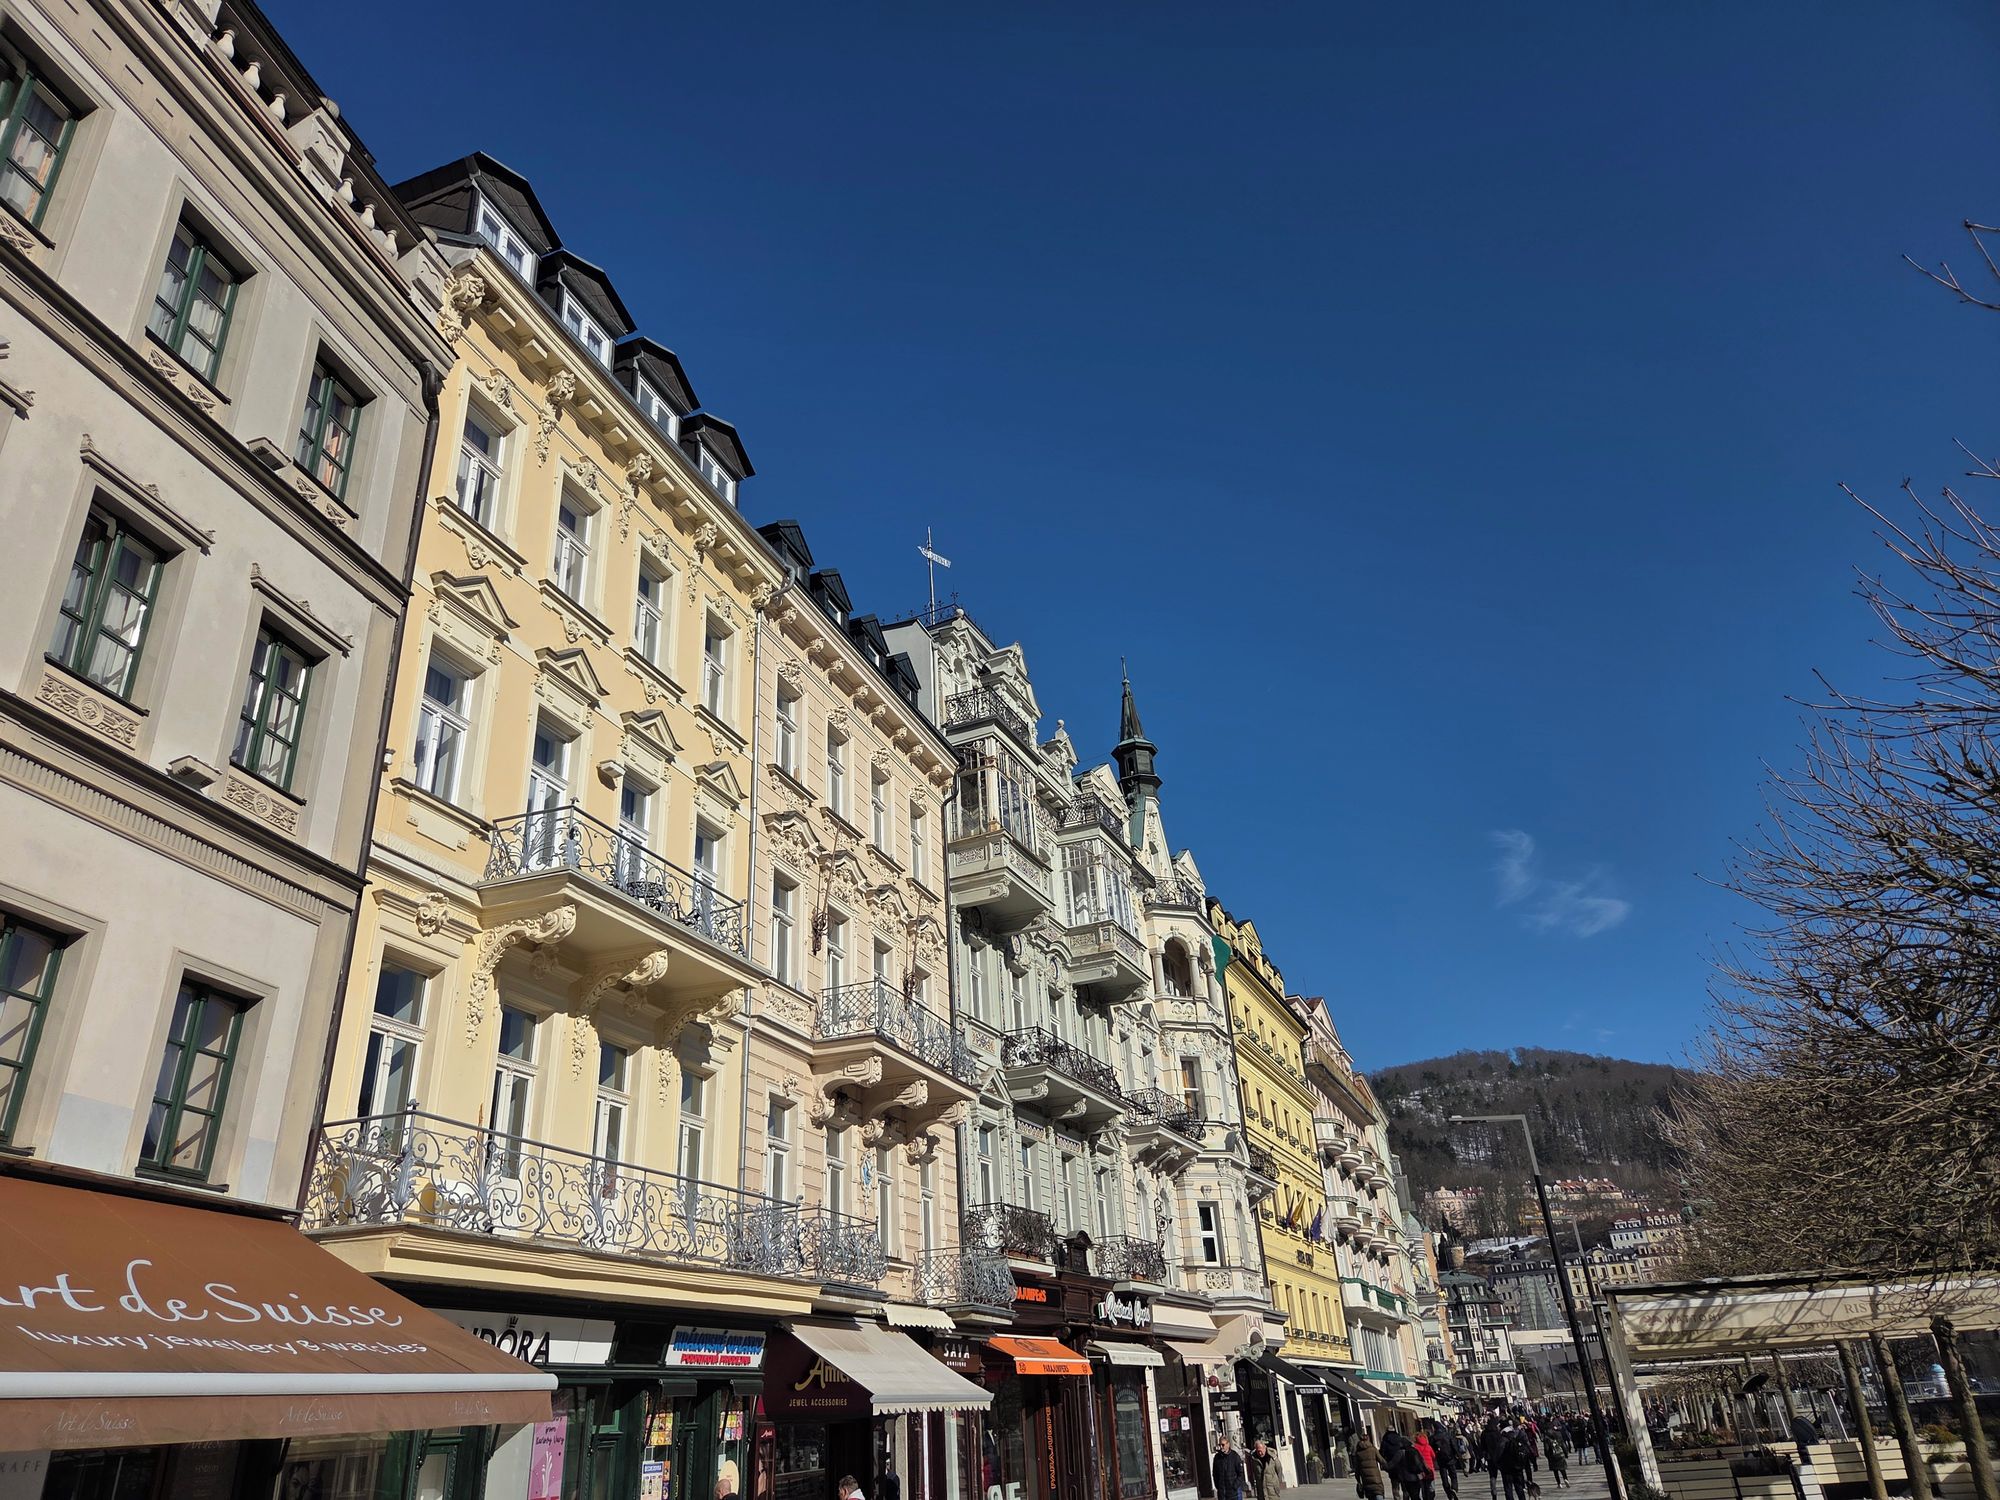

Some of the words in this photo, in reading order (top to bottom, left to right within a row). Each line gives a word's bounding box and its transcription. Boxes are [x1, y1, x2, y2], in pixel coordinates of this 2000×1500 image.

[0, 1274, 105, 1312] rt
[119, 1259, 209, 1322] de
[204, 1282, 403, 1328] Suisse
[16, 1325, 149, 1350] luxury
[148, 1333, 299, 1355] jewellery
[296, 1339, 321, 1352] &
[322, 1341, 427, 1354] watches
[943, 1342, 970, 1359] SAYA
[789, 1399, 808, 1407] JEWEL
[811, 1398, 848, 1406] ACCESSORIES
